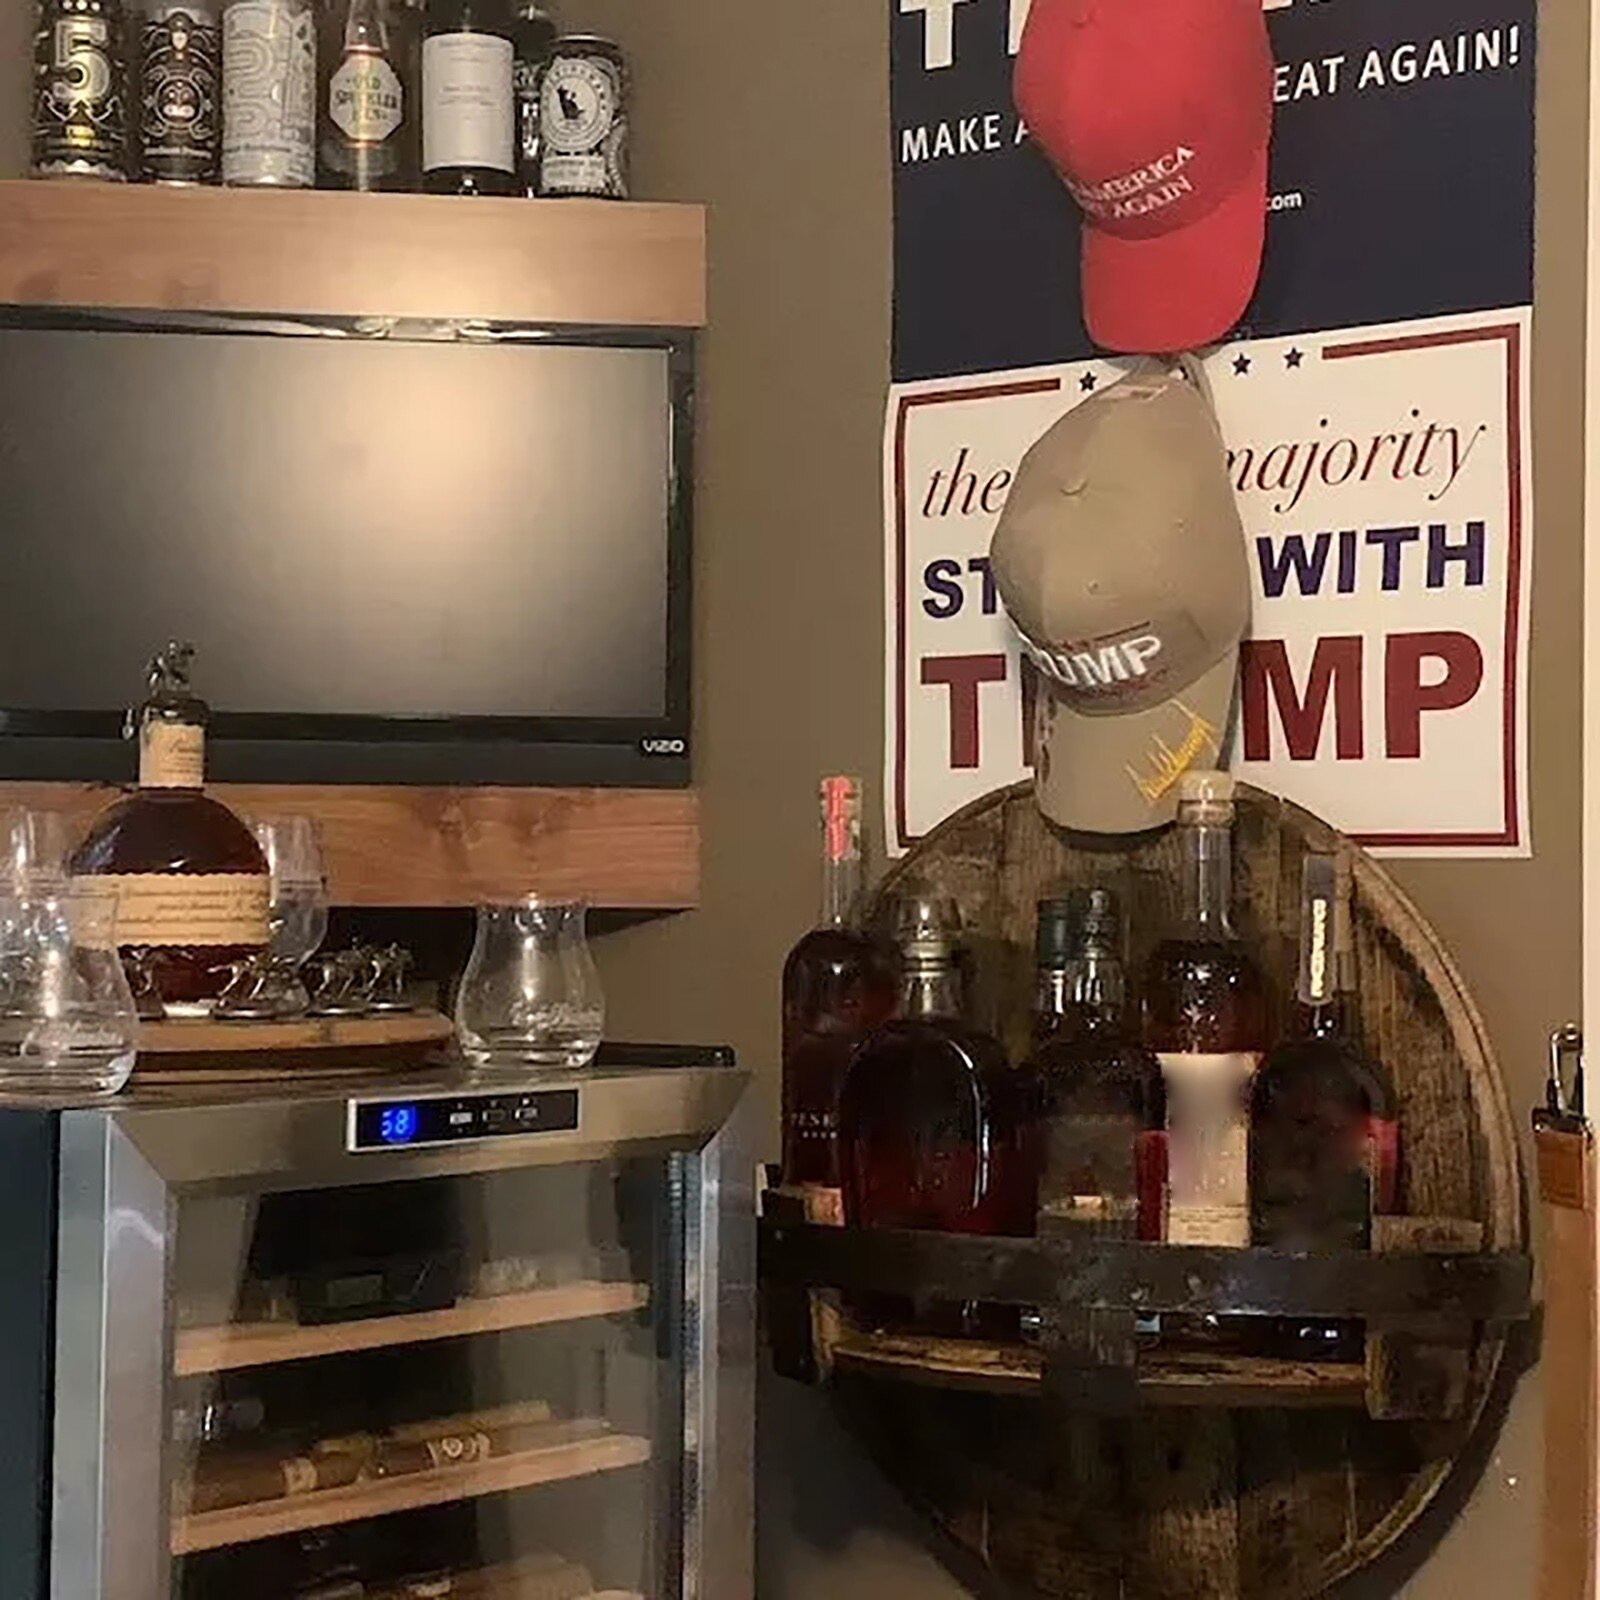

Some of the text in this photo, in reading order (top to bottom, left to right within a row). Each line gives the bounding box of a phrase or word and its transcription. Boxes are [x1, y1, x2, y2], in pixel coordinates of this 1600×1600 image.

[901, 113, 1001, 163] MAKE
[1273, 56, 1345, 102] EAT
[1358, 25, 1519, 90] AGAIN!
[1113, 175, 1193, 218] AGAIN
[922, 447, 1012, 519] the
[1255, 521, 1485, 598] WITH
[920, 630, 1485, 770] TMP
[641, 739, 685, 753] VIZIO
